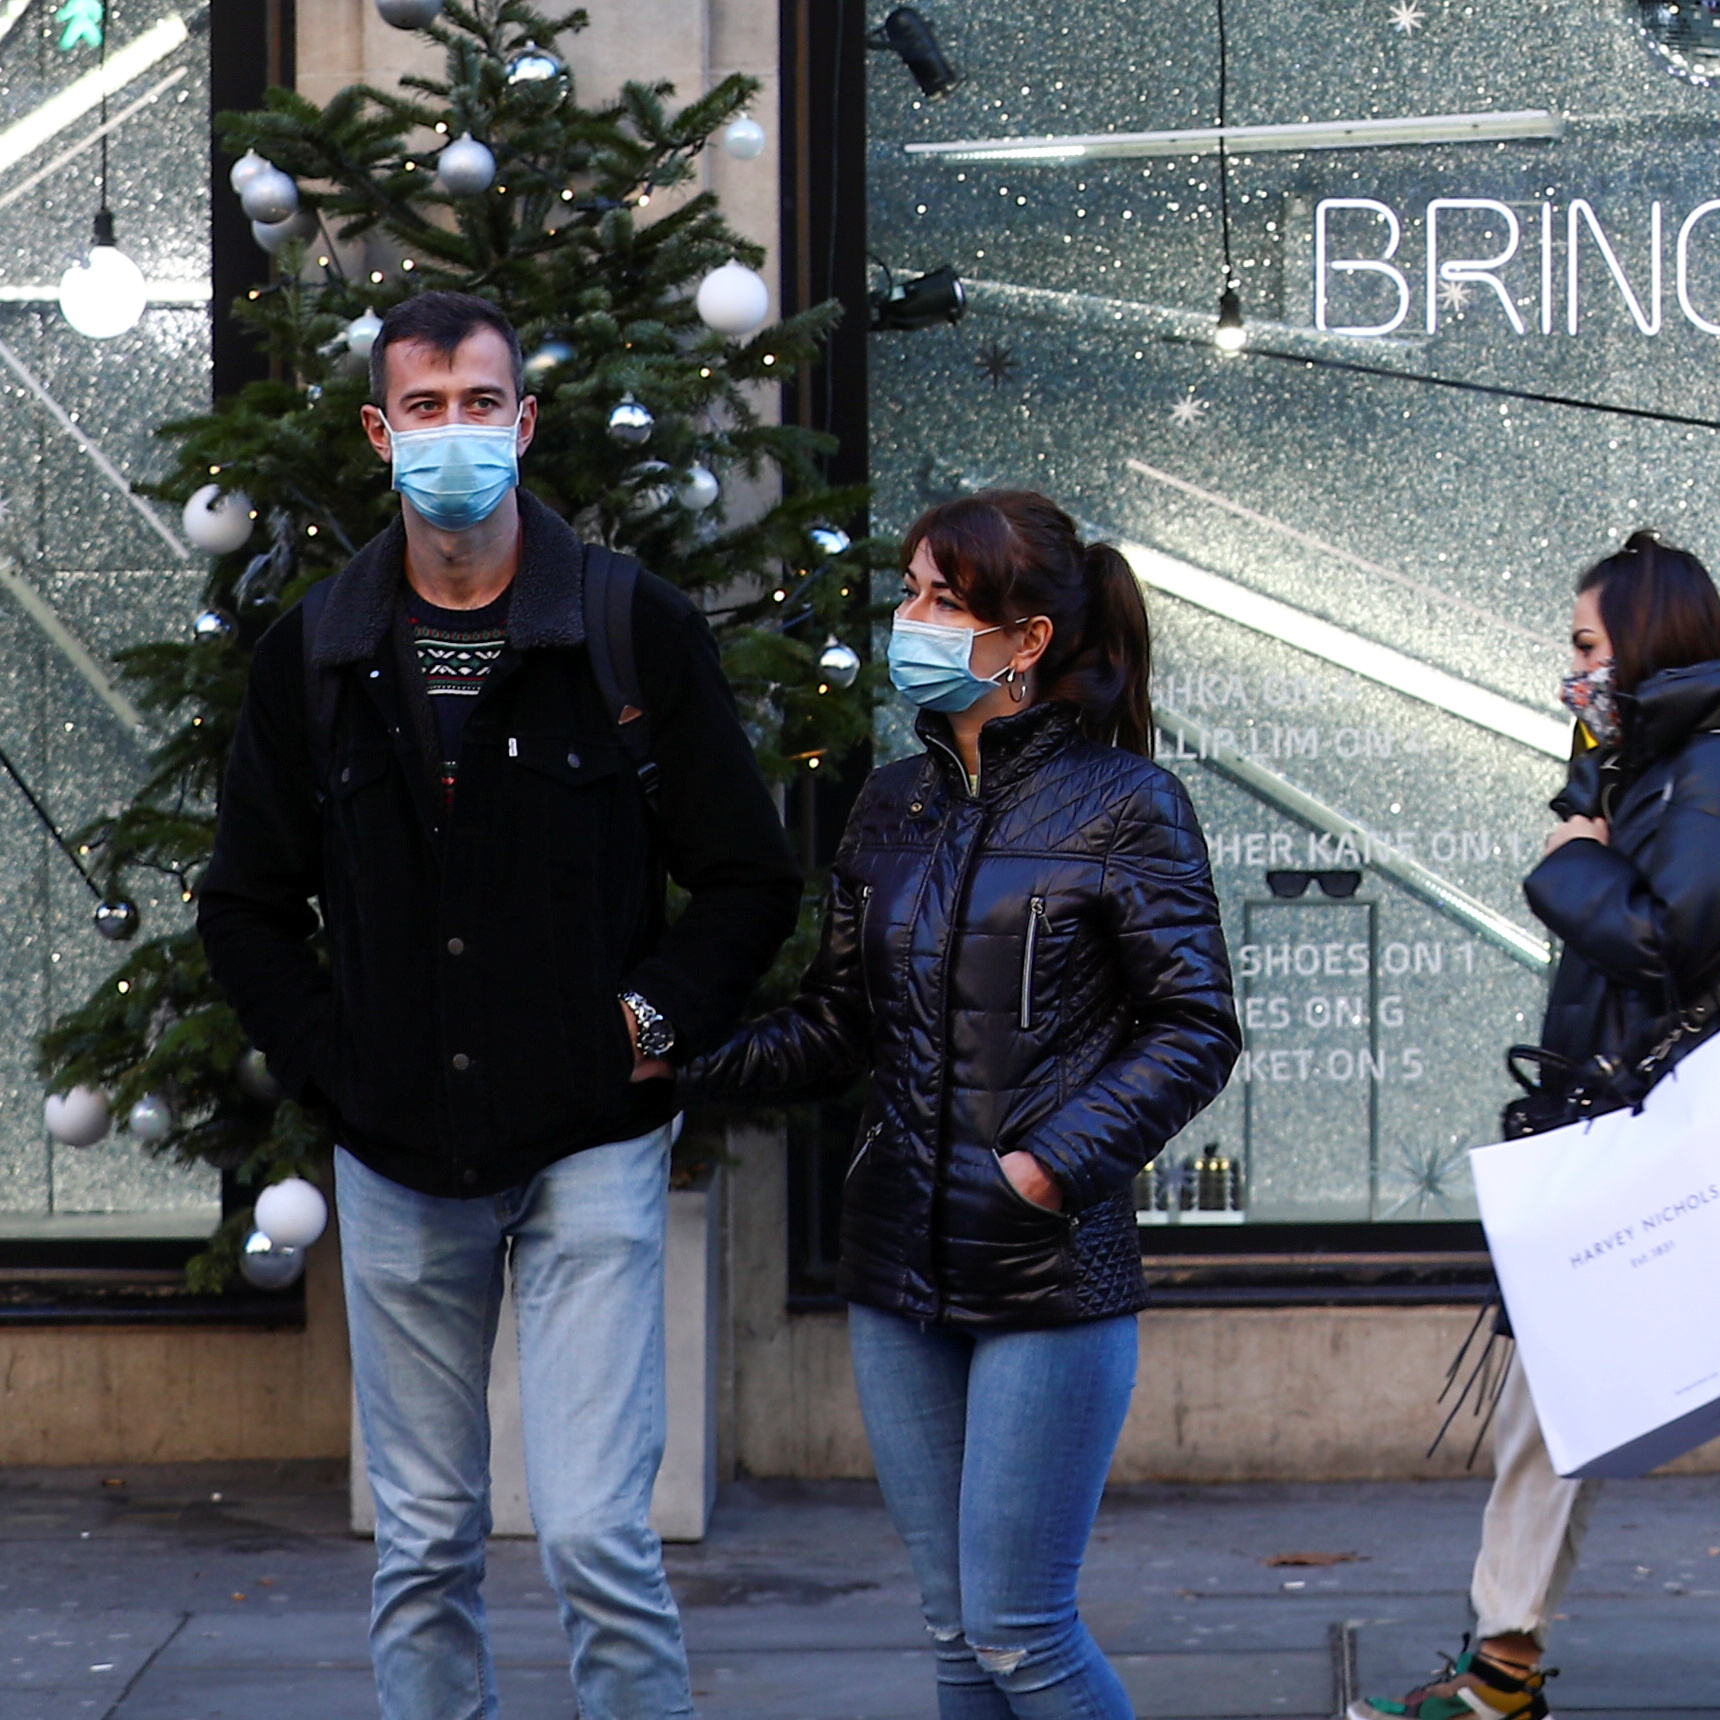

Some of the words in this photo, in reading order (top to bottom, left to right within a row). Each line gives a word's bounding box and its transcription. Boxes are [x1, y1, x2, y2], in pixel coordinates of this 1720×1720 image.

[1154, 729, 1237, 760] LLIP
[1250, 729, 1319, 760] LIM
[1335, 729, 1394, 760] ON
[1209, 832, 1293, 865] HER
[1431, 830, 1491, 863] ON
[1239, 942, 1370, 977] SHOES
[1384, 941, 1444, 976] ON
[1456, 941, 1475, 975] 1
[1235, 997, 1291, 1029] ES
[1304, 996, 1364, 1029] ON
[1378, 996, 1406, 1028] G
[1326, 1048, 1388, 1082] ON
[1401, 1048, 1426, 1080] 5
[1569, 1226, 1634, 1269] HARVEY
[1642, 1183, 1720, 1232] NICHOLS
